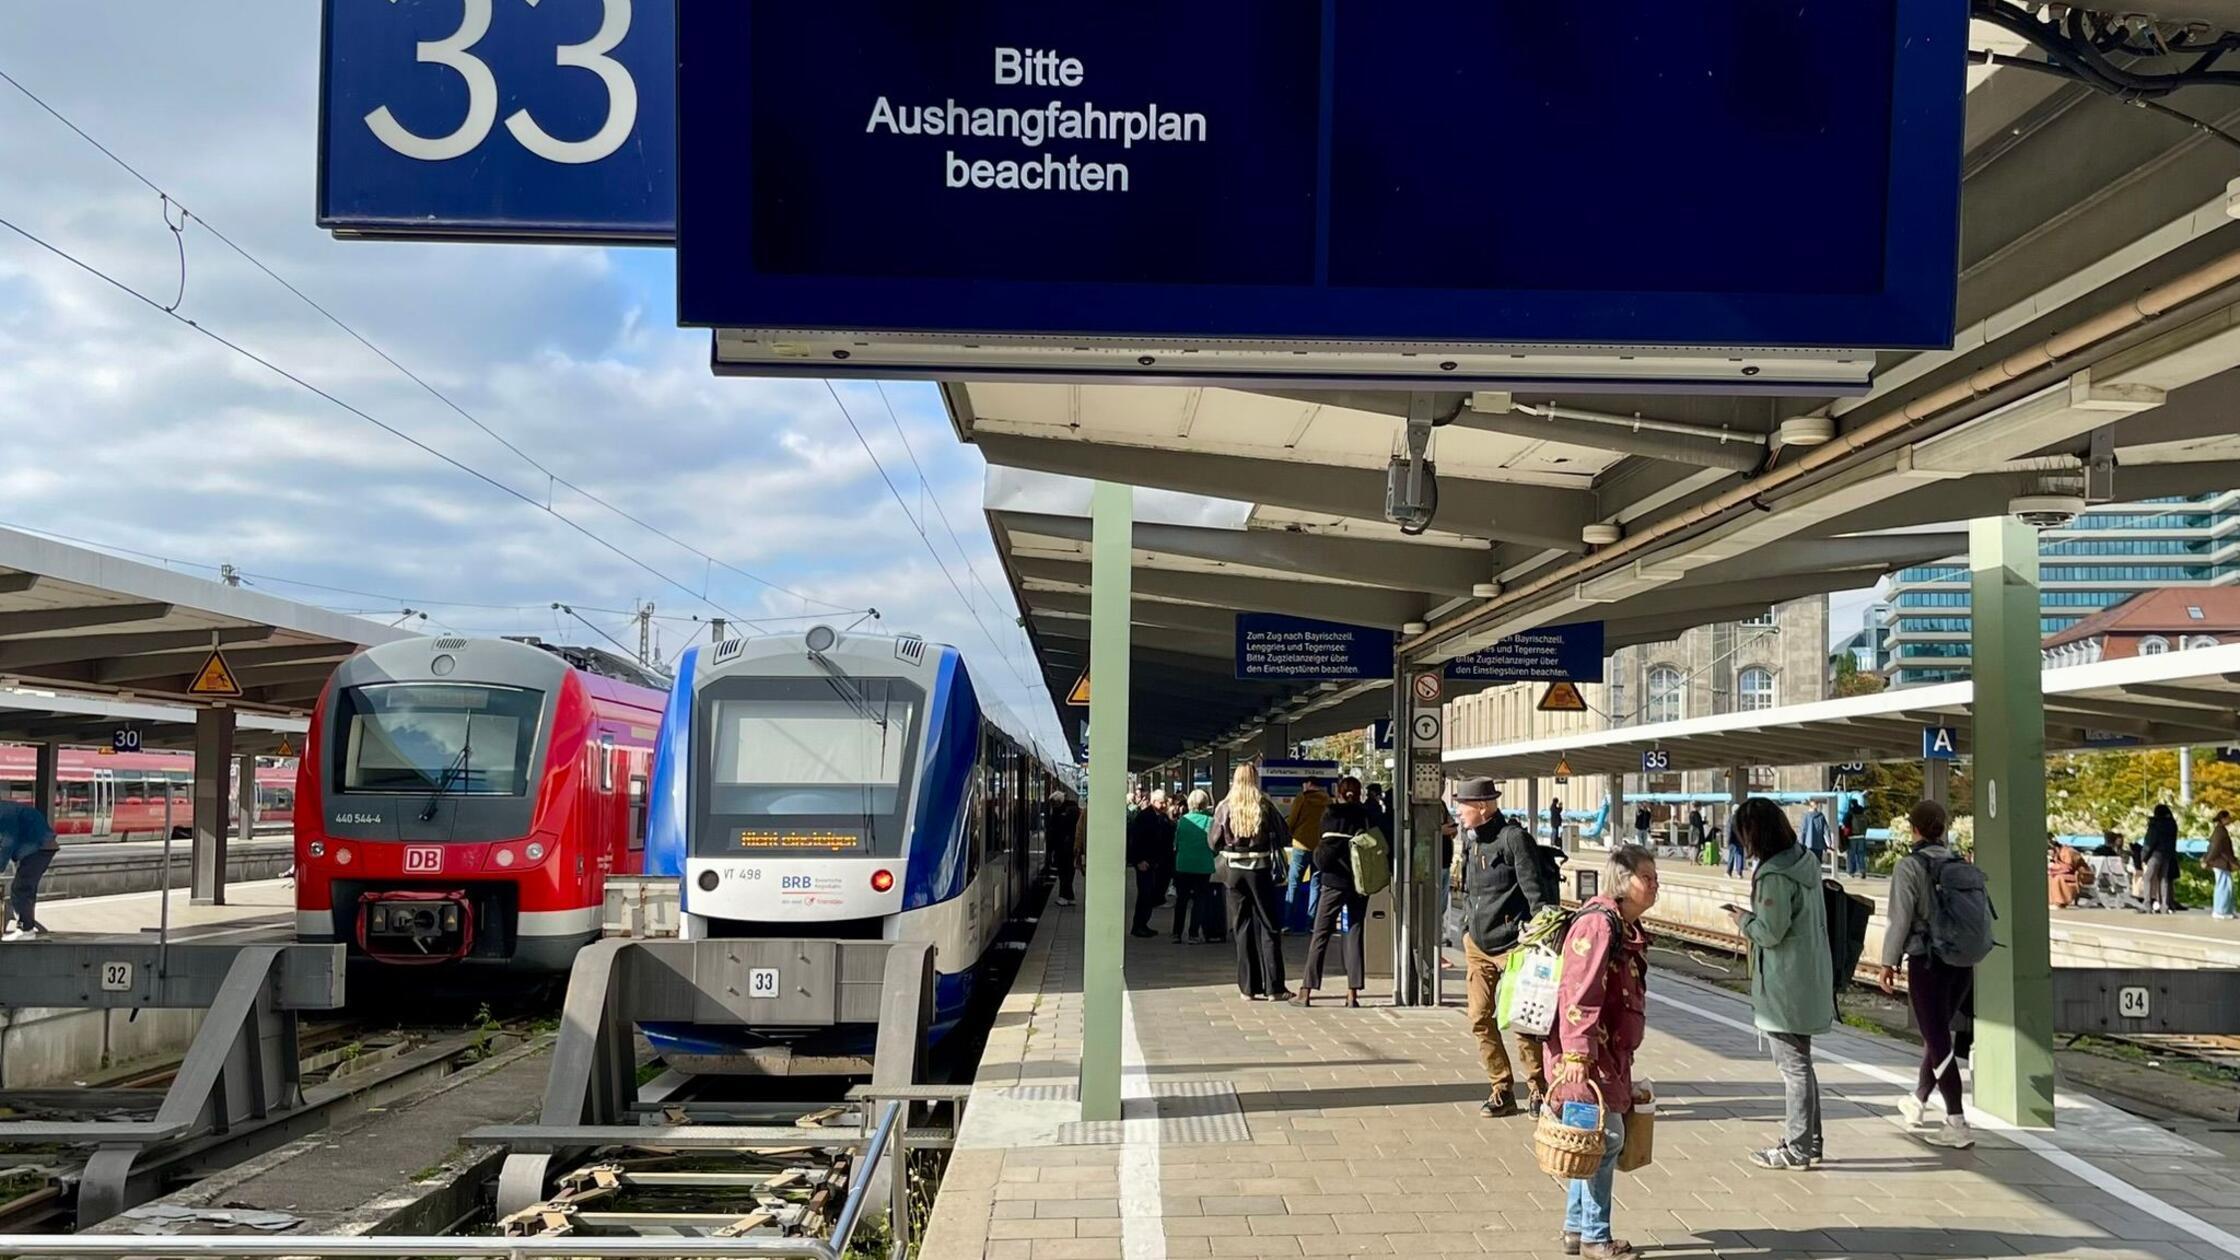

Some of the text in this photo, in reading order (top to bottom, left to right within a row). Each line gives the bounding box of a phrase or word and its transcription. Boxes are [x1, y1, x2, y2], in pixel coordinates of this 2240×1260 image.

[995, 47, 1084, 87] Bitte
[364, 0, 638, 163] 33
[866, 96, 1206, 149] Aushangfahrplan
[946, 150, 1129, 192] beachten
[1246, 632, 1264, 640] Zum
[1267, 632, 1282, 642] Zug
[1284, 632, 1303, 640] nach
[1246, 643, 1285, 653] Lenggries
[1287, 643, 1303, 651] und
[1497, 645, 1512, 653] und
[1246, 653, 1348, 664] Bitte Zugzielanzeiger über
[1476, 656, 1538, 666] Zugzielanzeiger
[1540, 657, 1559, 665] über
[1246, 665, 1262, 673] den
[1264, 665, 1320, 674] Einstiegstüren
[1456, 666, 1570, 677] den Einstiegstüren beachten.
[115, 730, 138, 747] 30
[1933, 728, 1953, 752] A
[1647, 751, 1667, 768] 35
[335, 813, 381, 823] 440 544-4
[408, 850, 439, 869] DB
[723, 869, 762, 880] VT 498
[782, 876, 812, 889] BRB
[108, 966, 126, 984] 32
[756, 973, 773, 990] 33
[2125, 992, 2144, 1010] 34
